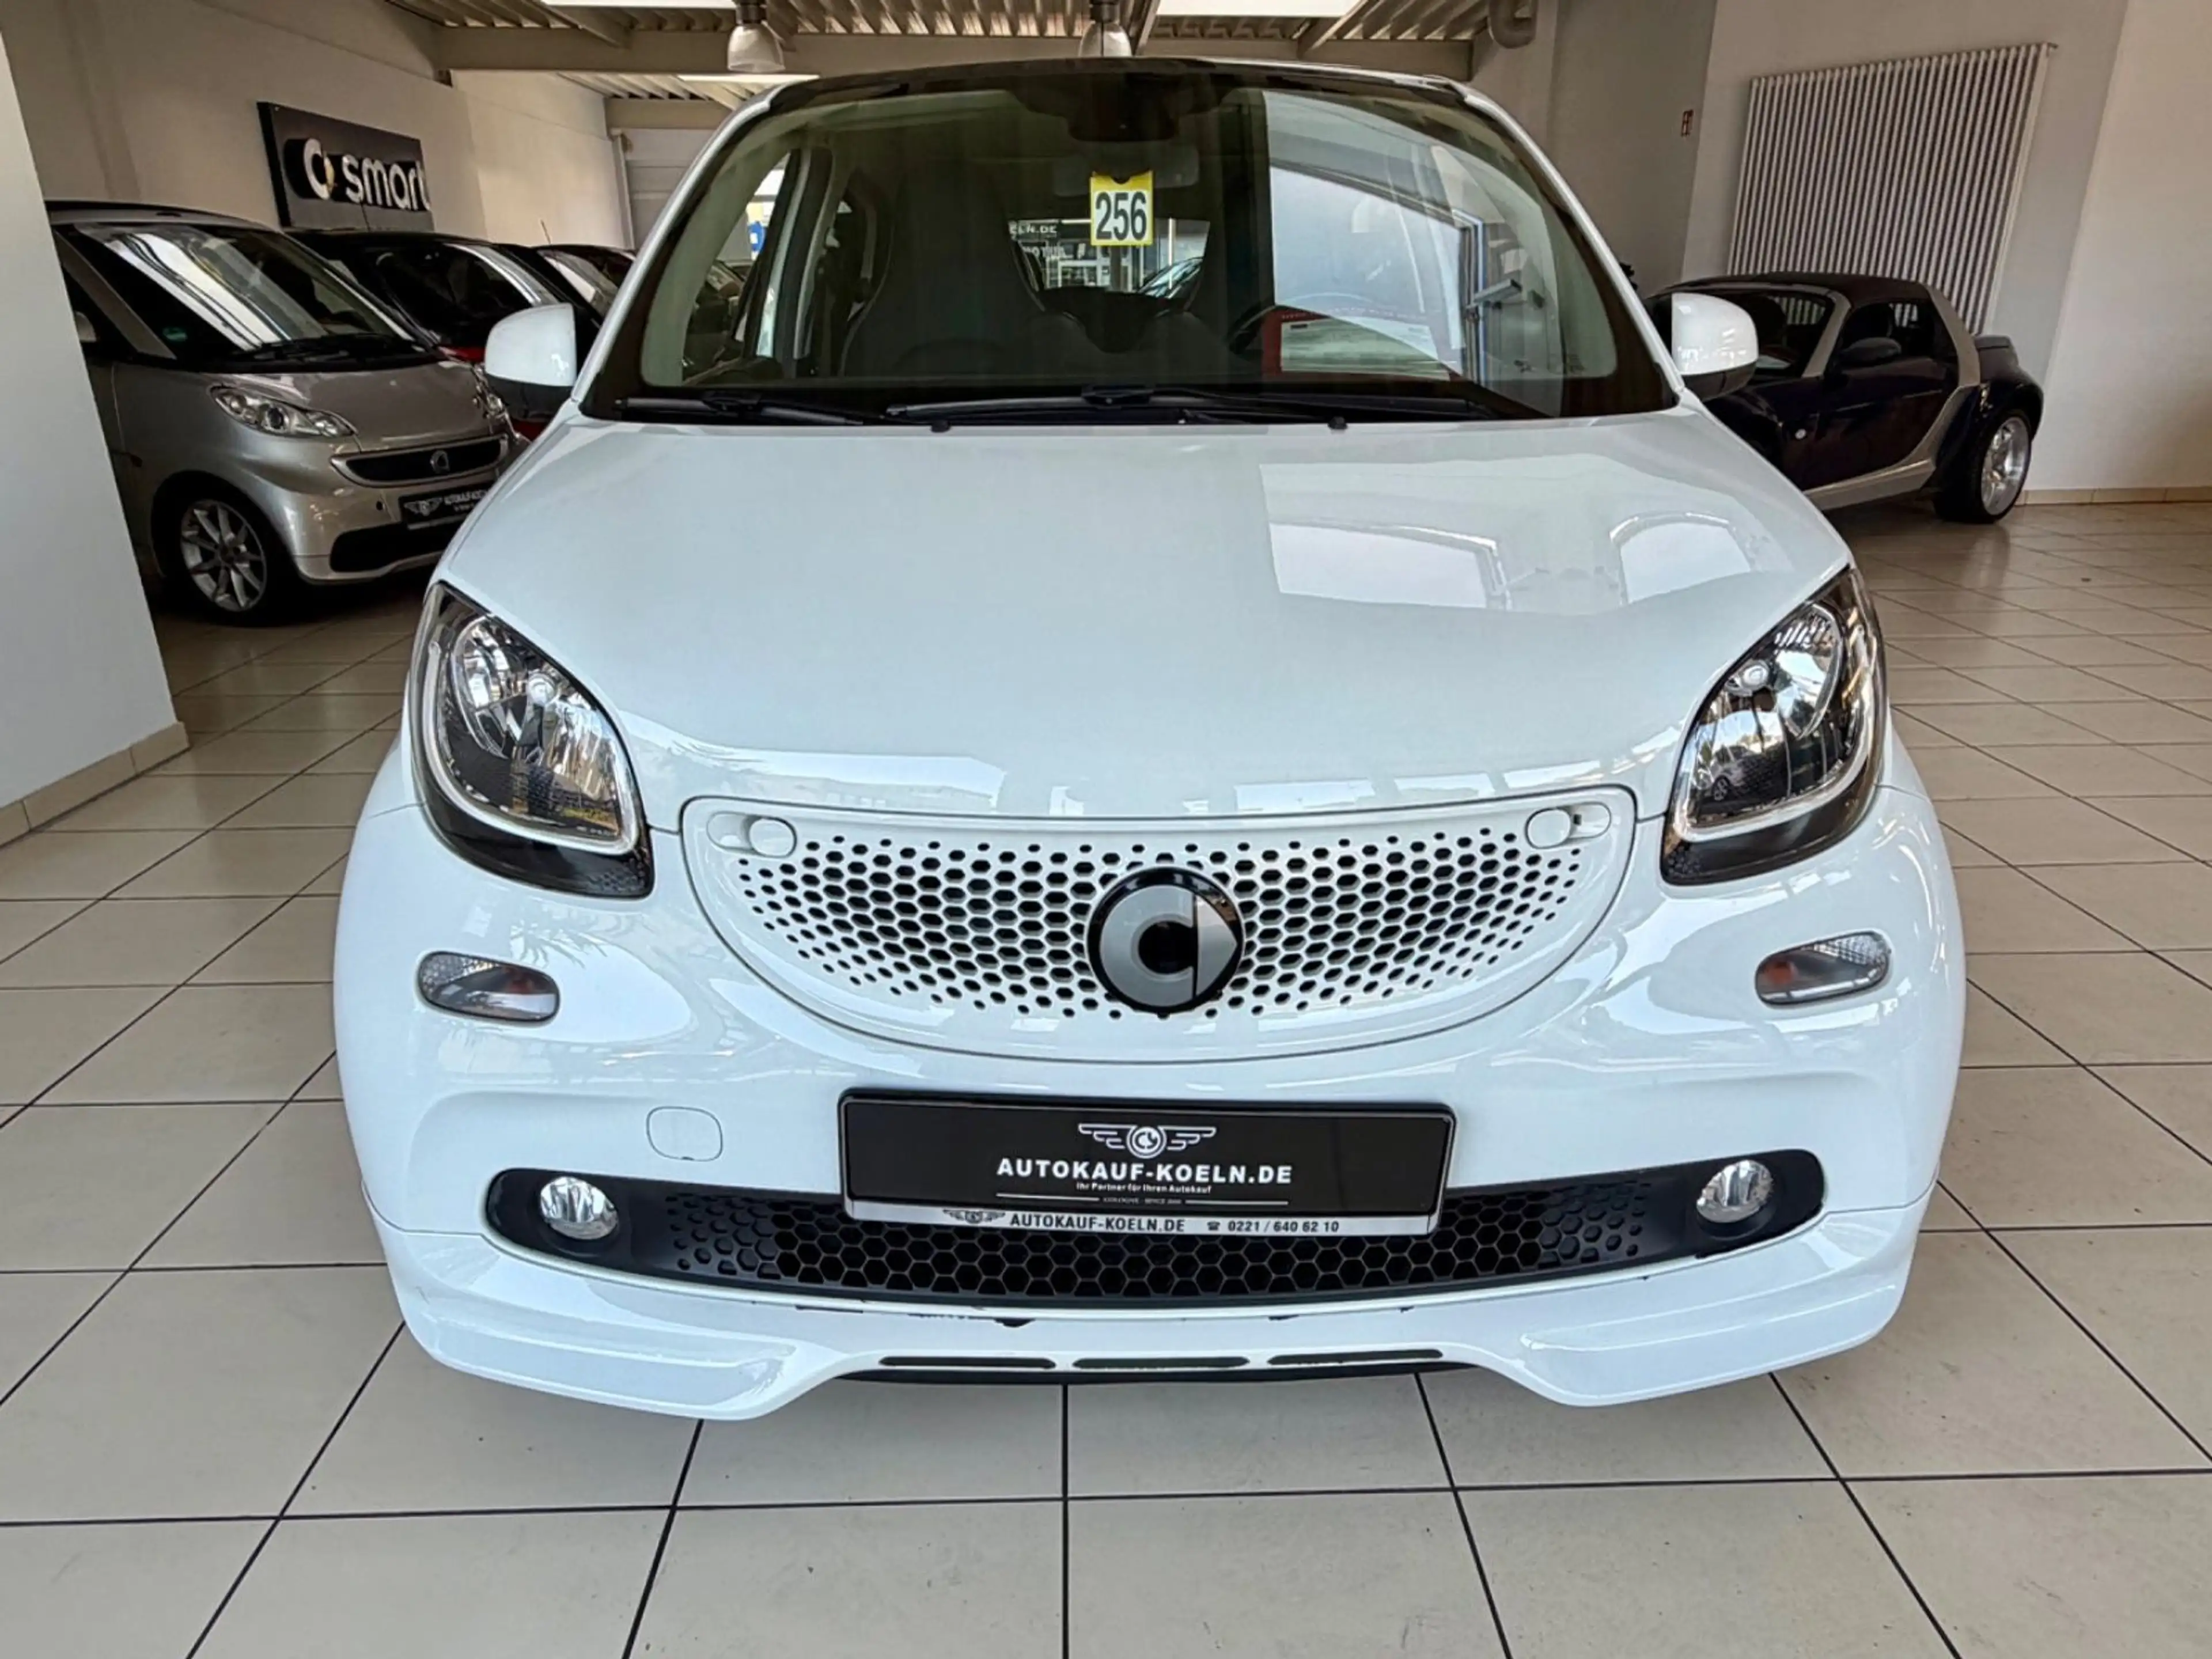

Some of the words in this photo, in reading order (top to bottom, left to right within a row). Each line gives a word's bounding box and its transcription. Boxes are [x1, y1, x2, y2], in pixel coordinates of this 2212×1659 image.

[341, 154, 431, 211] smart
[1095, 191, 1146, 241] 256
[996, 1157, 1293, 1184] AUTOKAUF-KOELN.DE
[1075, 1182, 1090, 1190] Ihr
[1092, 1183, 1126, 1192] Partner
[1143, 1183, 1168, 1192] Ihren
[1168, 1184, 1212, 1194] Autokauf
[1010, 1213, 1185, 1232] AUTOKAUF-KOELN.DE
[1228, 1221, 1260, 1232] 0221
[1273, 1221, 1298, 1232] 640
[1302, 1221, 1319, 1233] 62
[1323, 1221, 1339, 1232] 10
